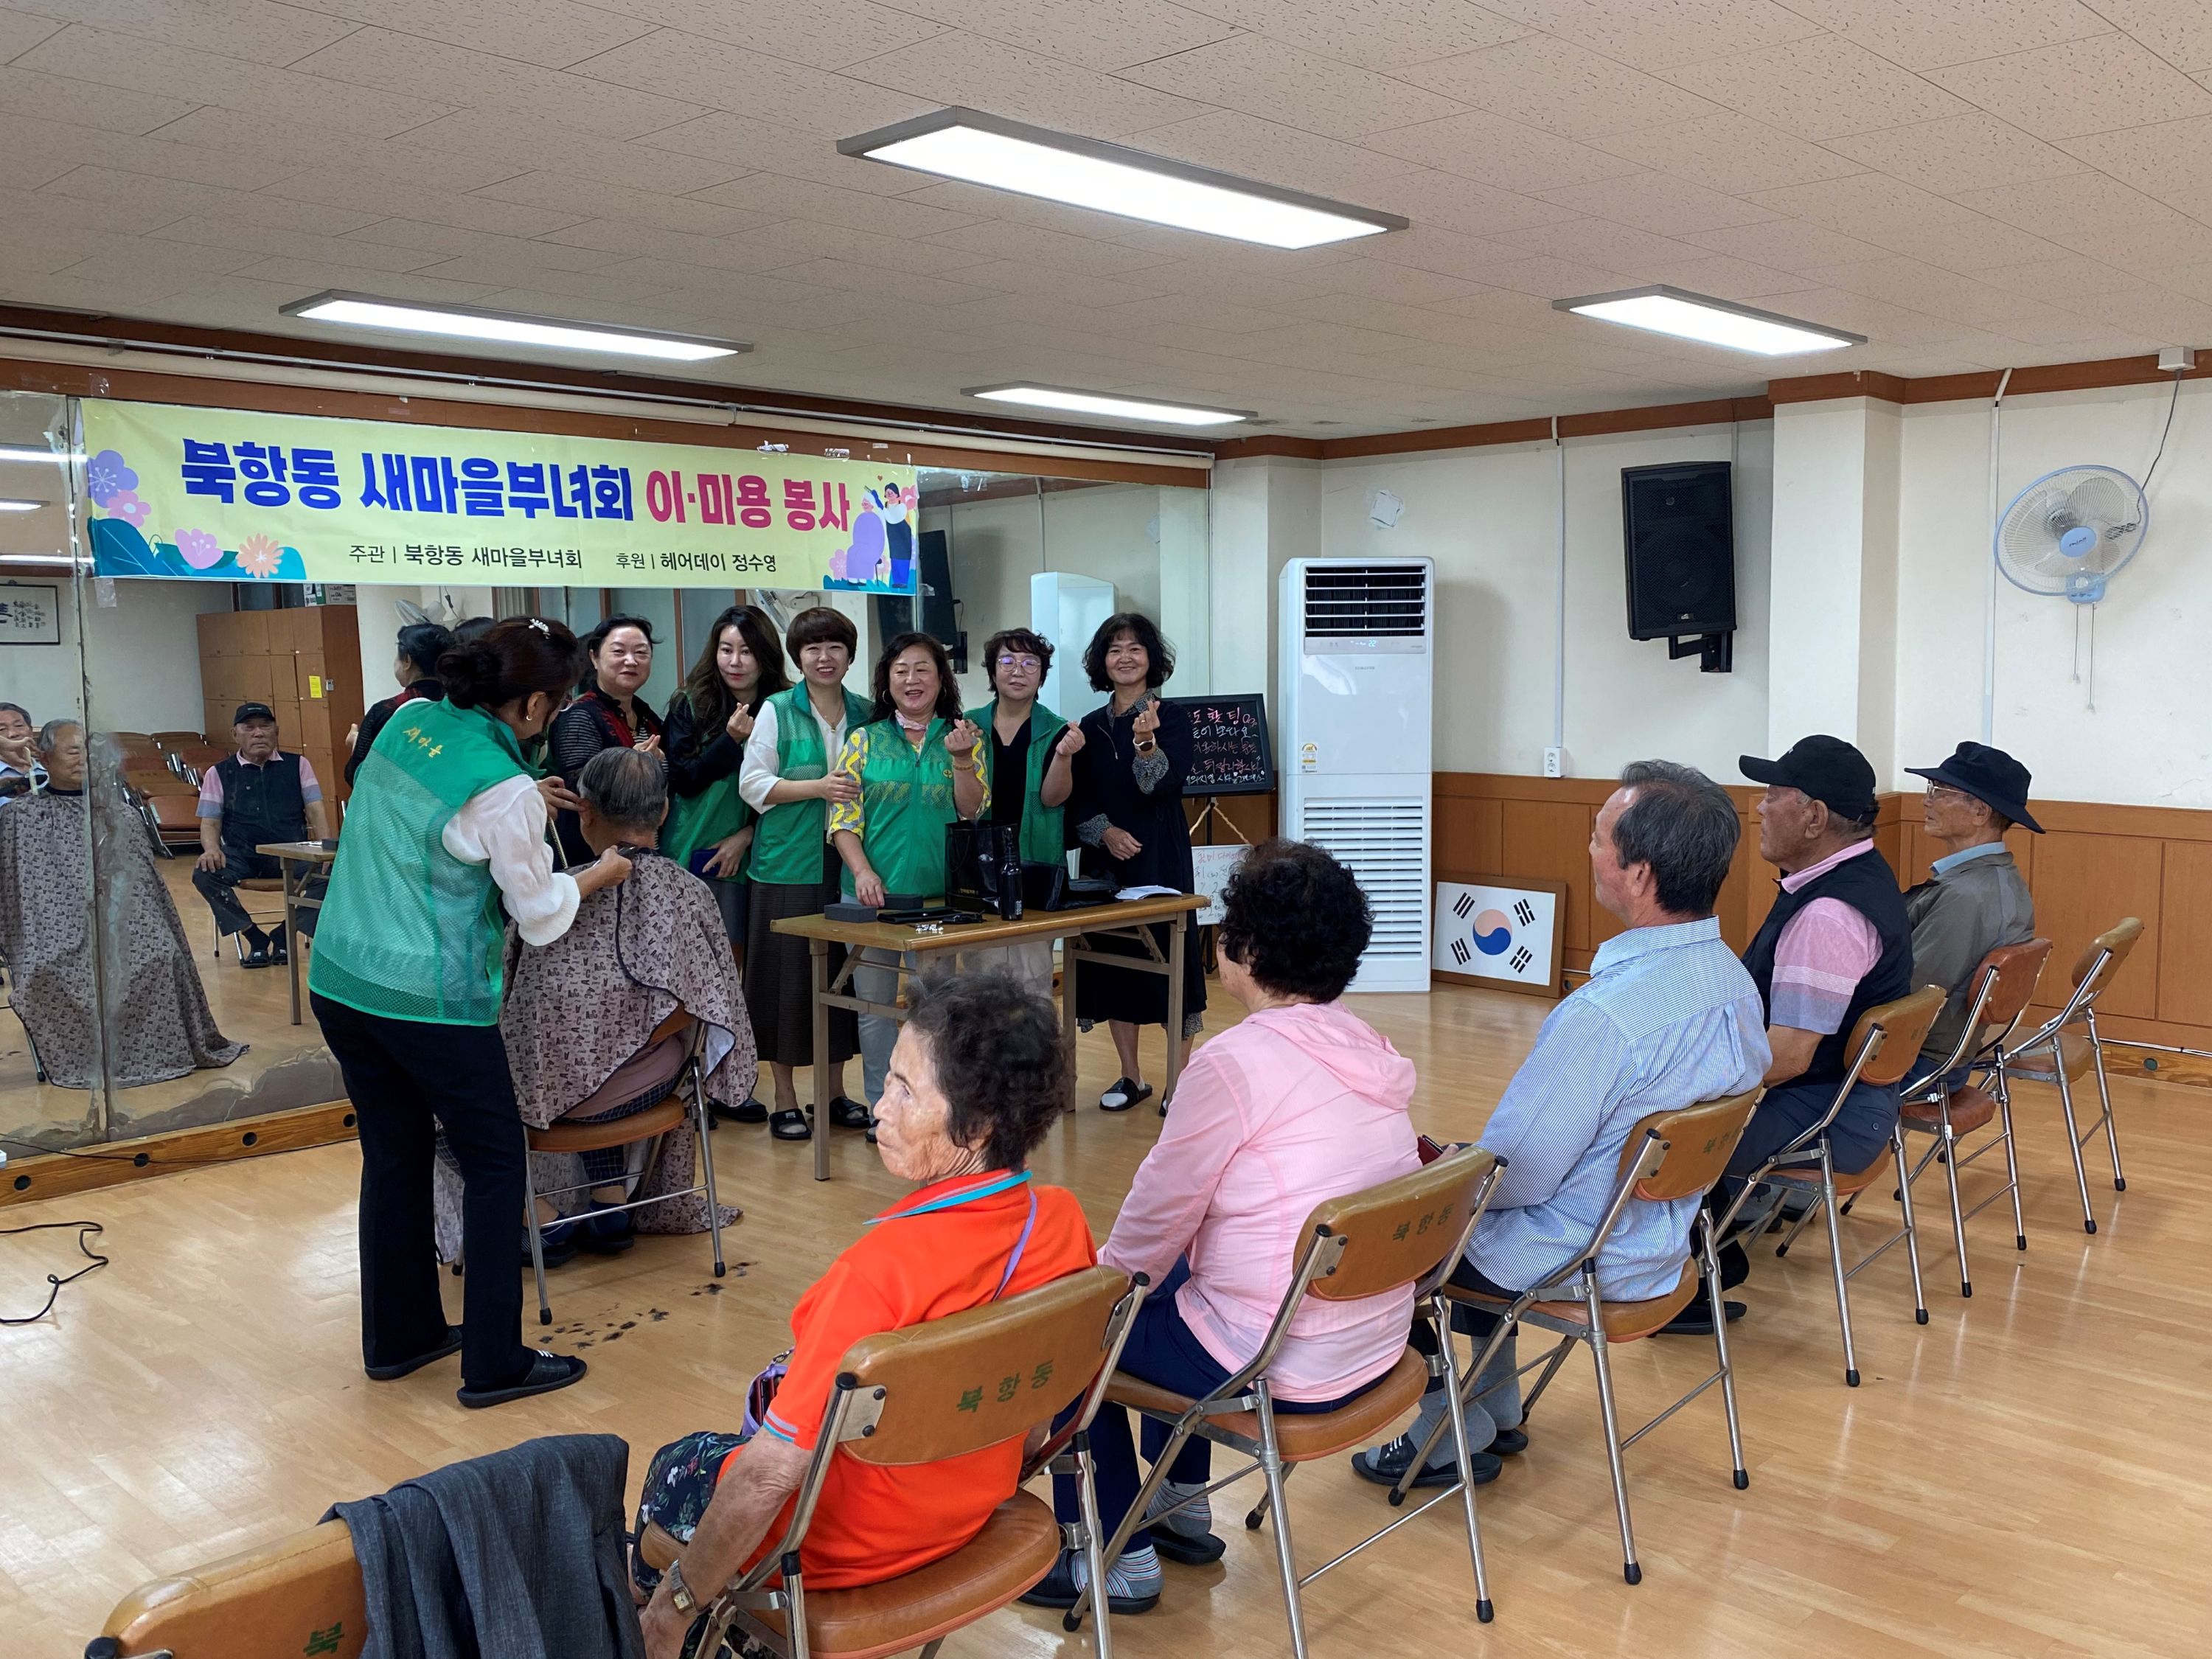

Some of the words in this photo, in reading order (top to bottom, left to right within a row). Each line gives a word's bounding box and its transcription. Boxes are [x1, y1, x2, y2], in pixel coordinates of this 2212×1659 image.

[182, 437, 341, 509] 북항동
[359, 451, 634, 521] 새마을부녀회
[784, 479, 851, 532] 봉사
[348, 543, 386, 563] 주관
[403, 543, 465, 567] 북항동
[471, 546, 582, 569] 새마을부녀회
[615, 552, 647, 569] 후원
[660, 551, 727, 572] 헤어데이
[731, 552, 776, 573] 정수영
[1368, 639, 1377, 647] 22
[402, 726, 443, 758] 새마을
[956, 1358, 1054, 1413] 북항동
